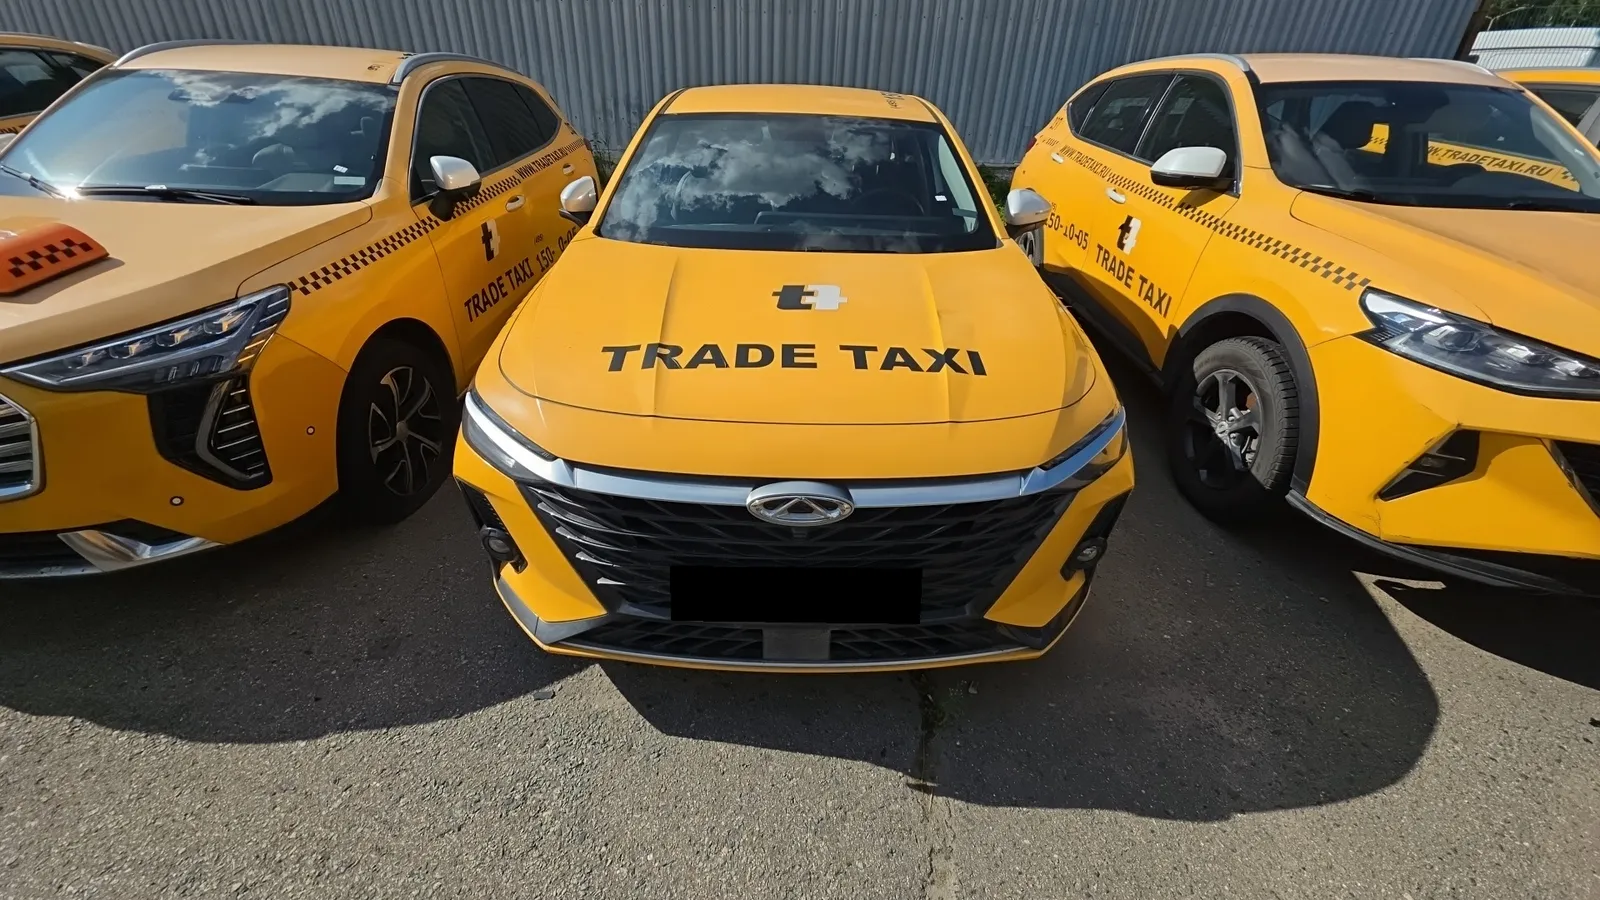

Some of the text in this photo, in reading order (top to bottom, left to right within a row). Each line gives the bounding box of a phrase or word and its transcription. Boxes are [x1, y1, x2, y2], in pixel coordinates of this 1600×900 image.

[464, 275, 508, 322] TRADE
[505, 257, 534, 291] TAXI
[1044, 212, 1172, 318] 50-10-05 TRADE TAXI
[601, 343, 988, 376] TRADE TAXI
